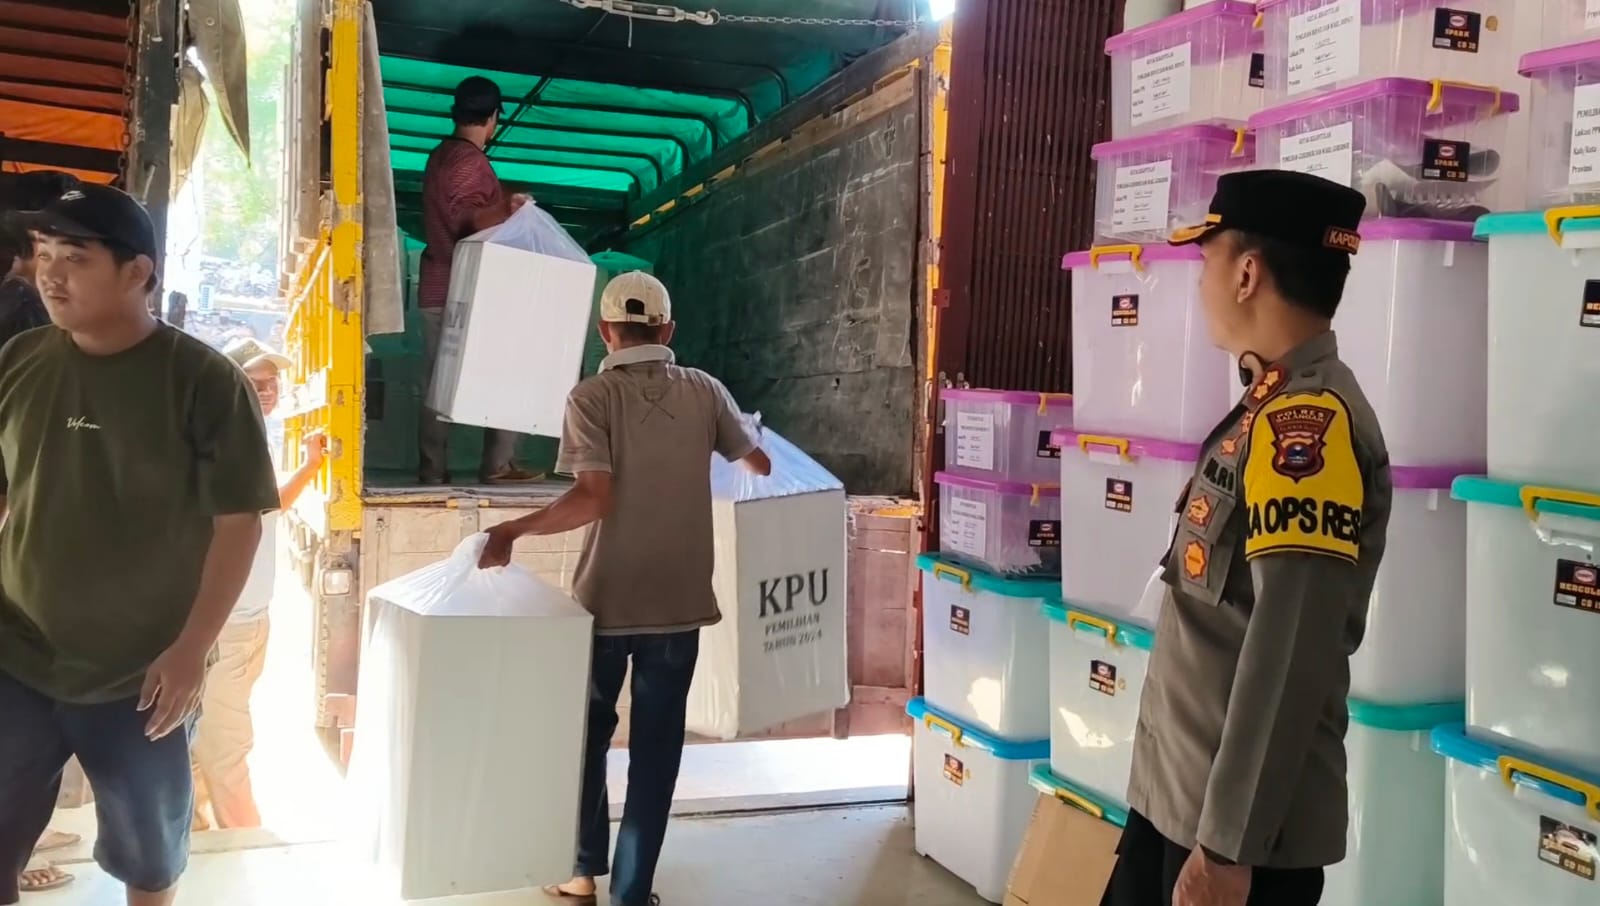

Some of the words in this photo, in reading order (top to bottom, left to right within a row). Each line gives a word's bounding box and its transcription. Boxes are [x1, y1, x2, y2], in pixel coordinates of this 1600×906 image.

[1264, 496, 1318, 534] OPS
[1322, 500, 1361, 545] RES
[758, 567, 828, 619] KPU
[765, 612, 820, 636] PEMILIHAN
[763, 635, 797, 653] TAHUN
